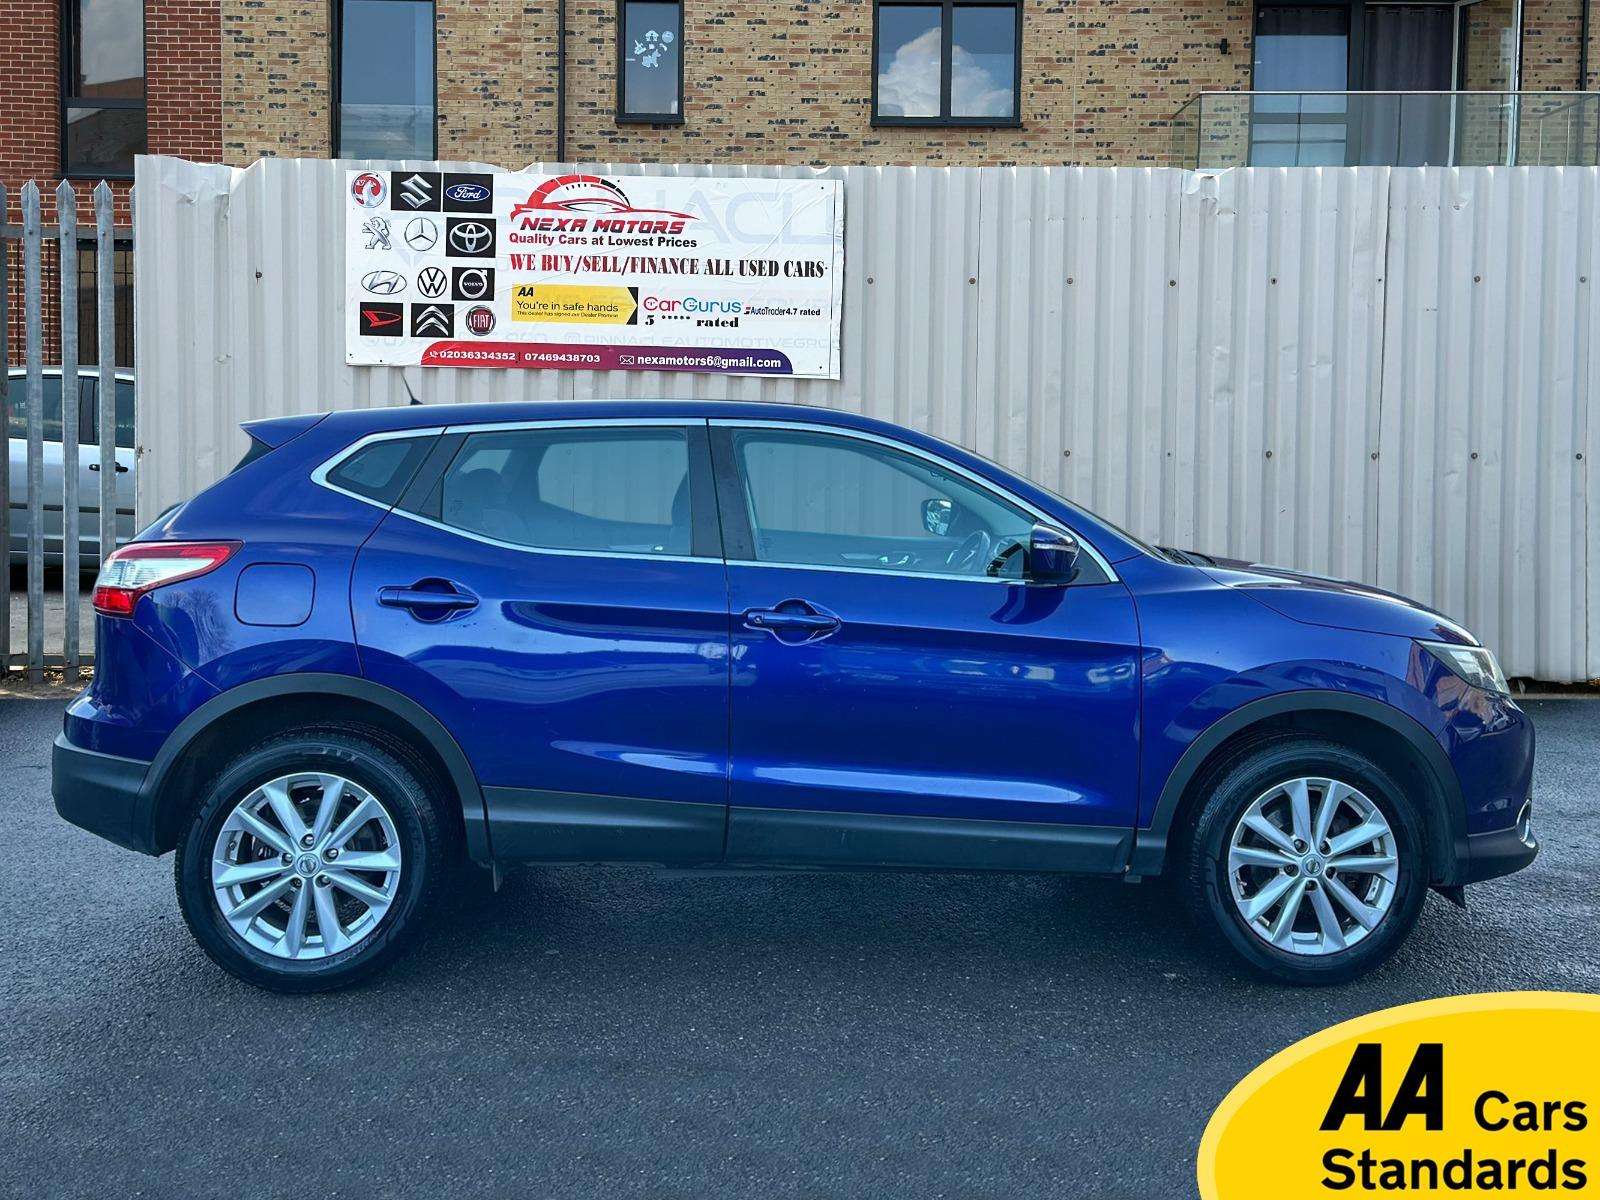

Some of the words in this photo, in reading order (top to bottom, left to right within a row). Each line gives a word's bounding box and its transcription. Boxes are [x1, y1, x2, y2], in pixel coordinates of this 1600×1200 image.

[454, 187, 481, 199] Ford
[520, 217, 588, 232] NEXA
[592, 219, 686, 234] MOTORS
[509, 233, 554, 246] Quality
[558, 234, 587, 245] Cars
[591, 235, 604, 246] at
[608, 235, 654, 247] Lowest
[657, 236, 697, 248] Prices
[509, 254, 536, 271] WE
[704, 258, 734, 276] ALL
[739, 260, 780, 277] USED
[783, 260, 825, 278] CARS
[518, 287, 534, 297] AA
[516, 300, 549, 310] You're
[551, 301, 560, 310] in
[562, 302, 585, 311] safe
[587, 303, 619, 312] hands
[643, 296, 742, 313] CarGurus
[799, 308, 821, 316] rated
[473, 314, 490, 328] FIAT
[696, 317, 739, 328] rated
[440, 351, 516, 361] 02036334352
[524, 352, 601, 363] 07469438703
[637, 356, 781, 369] nexamotors6@gmail.com
